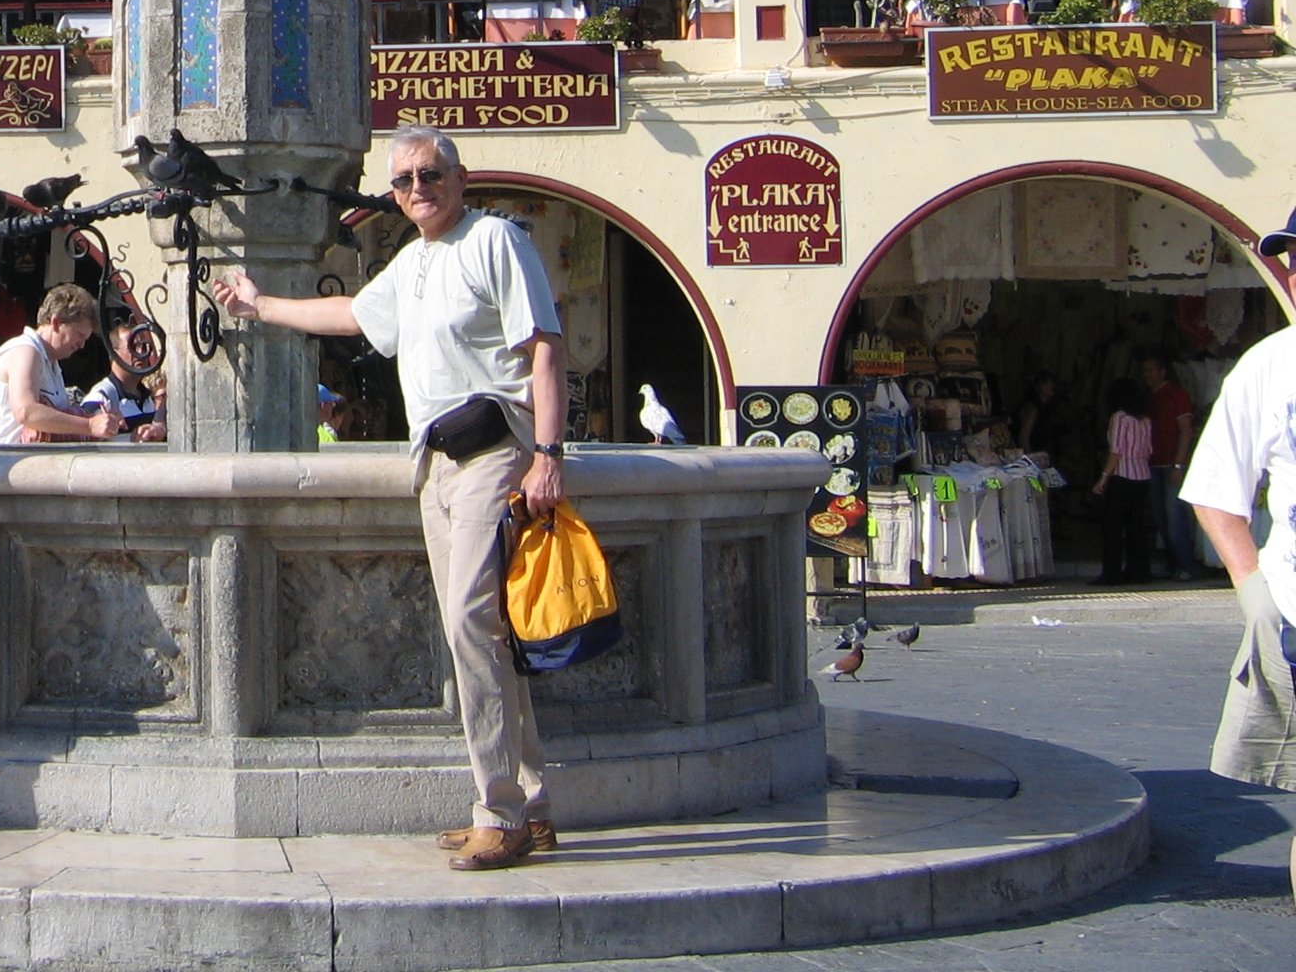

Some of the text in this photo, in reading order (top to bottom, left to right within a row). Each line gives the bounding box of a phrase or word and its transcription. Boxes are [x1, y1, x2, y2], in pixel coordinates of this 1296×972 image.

[515, 48, 535, 70] &
[937, 30, 1203, 74] RESTAURANT
[941, 98, 1009, 113] STEAK
[1141, 94, 1203, 109] FOOD
[396, 104, 569, 127] SEA FOOD
[708, 139, 838, 179] RESTAURANT
[728, 210, 821, 233] entrance
